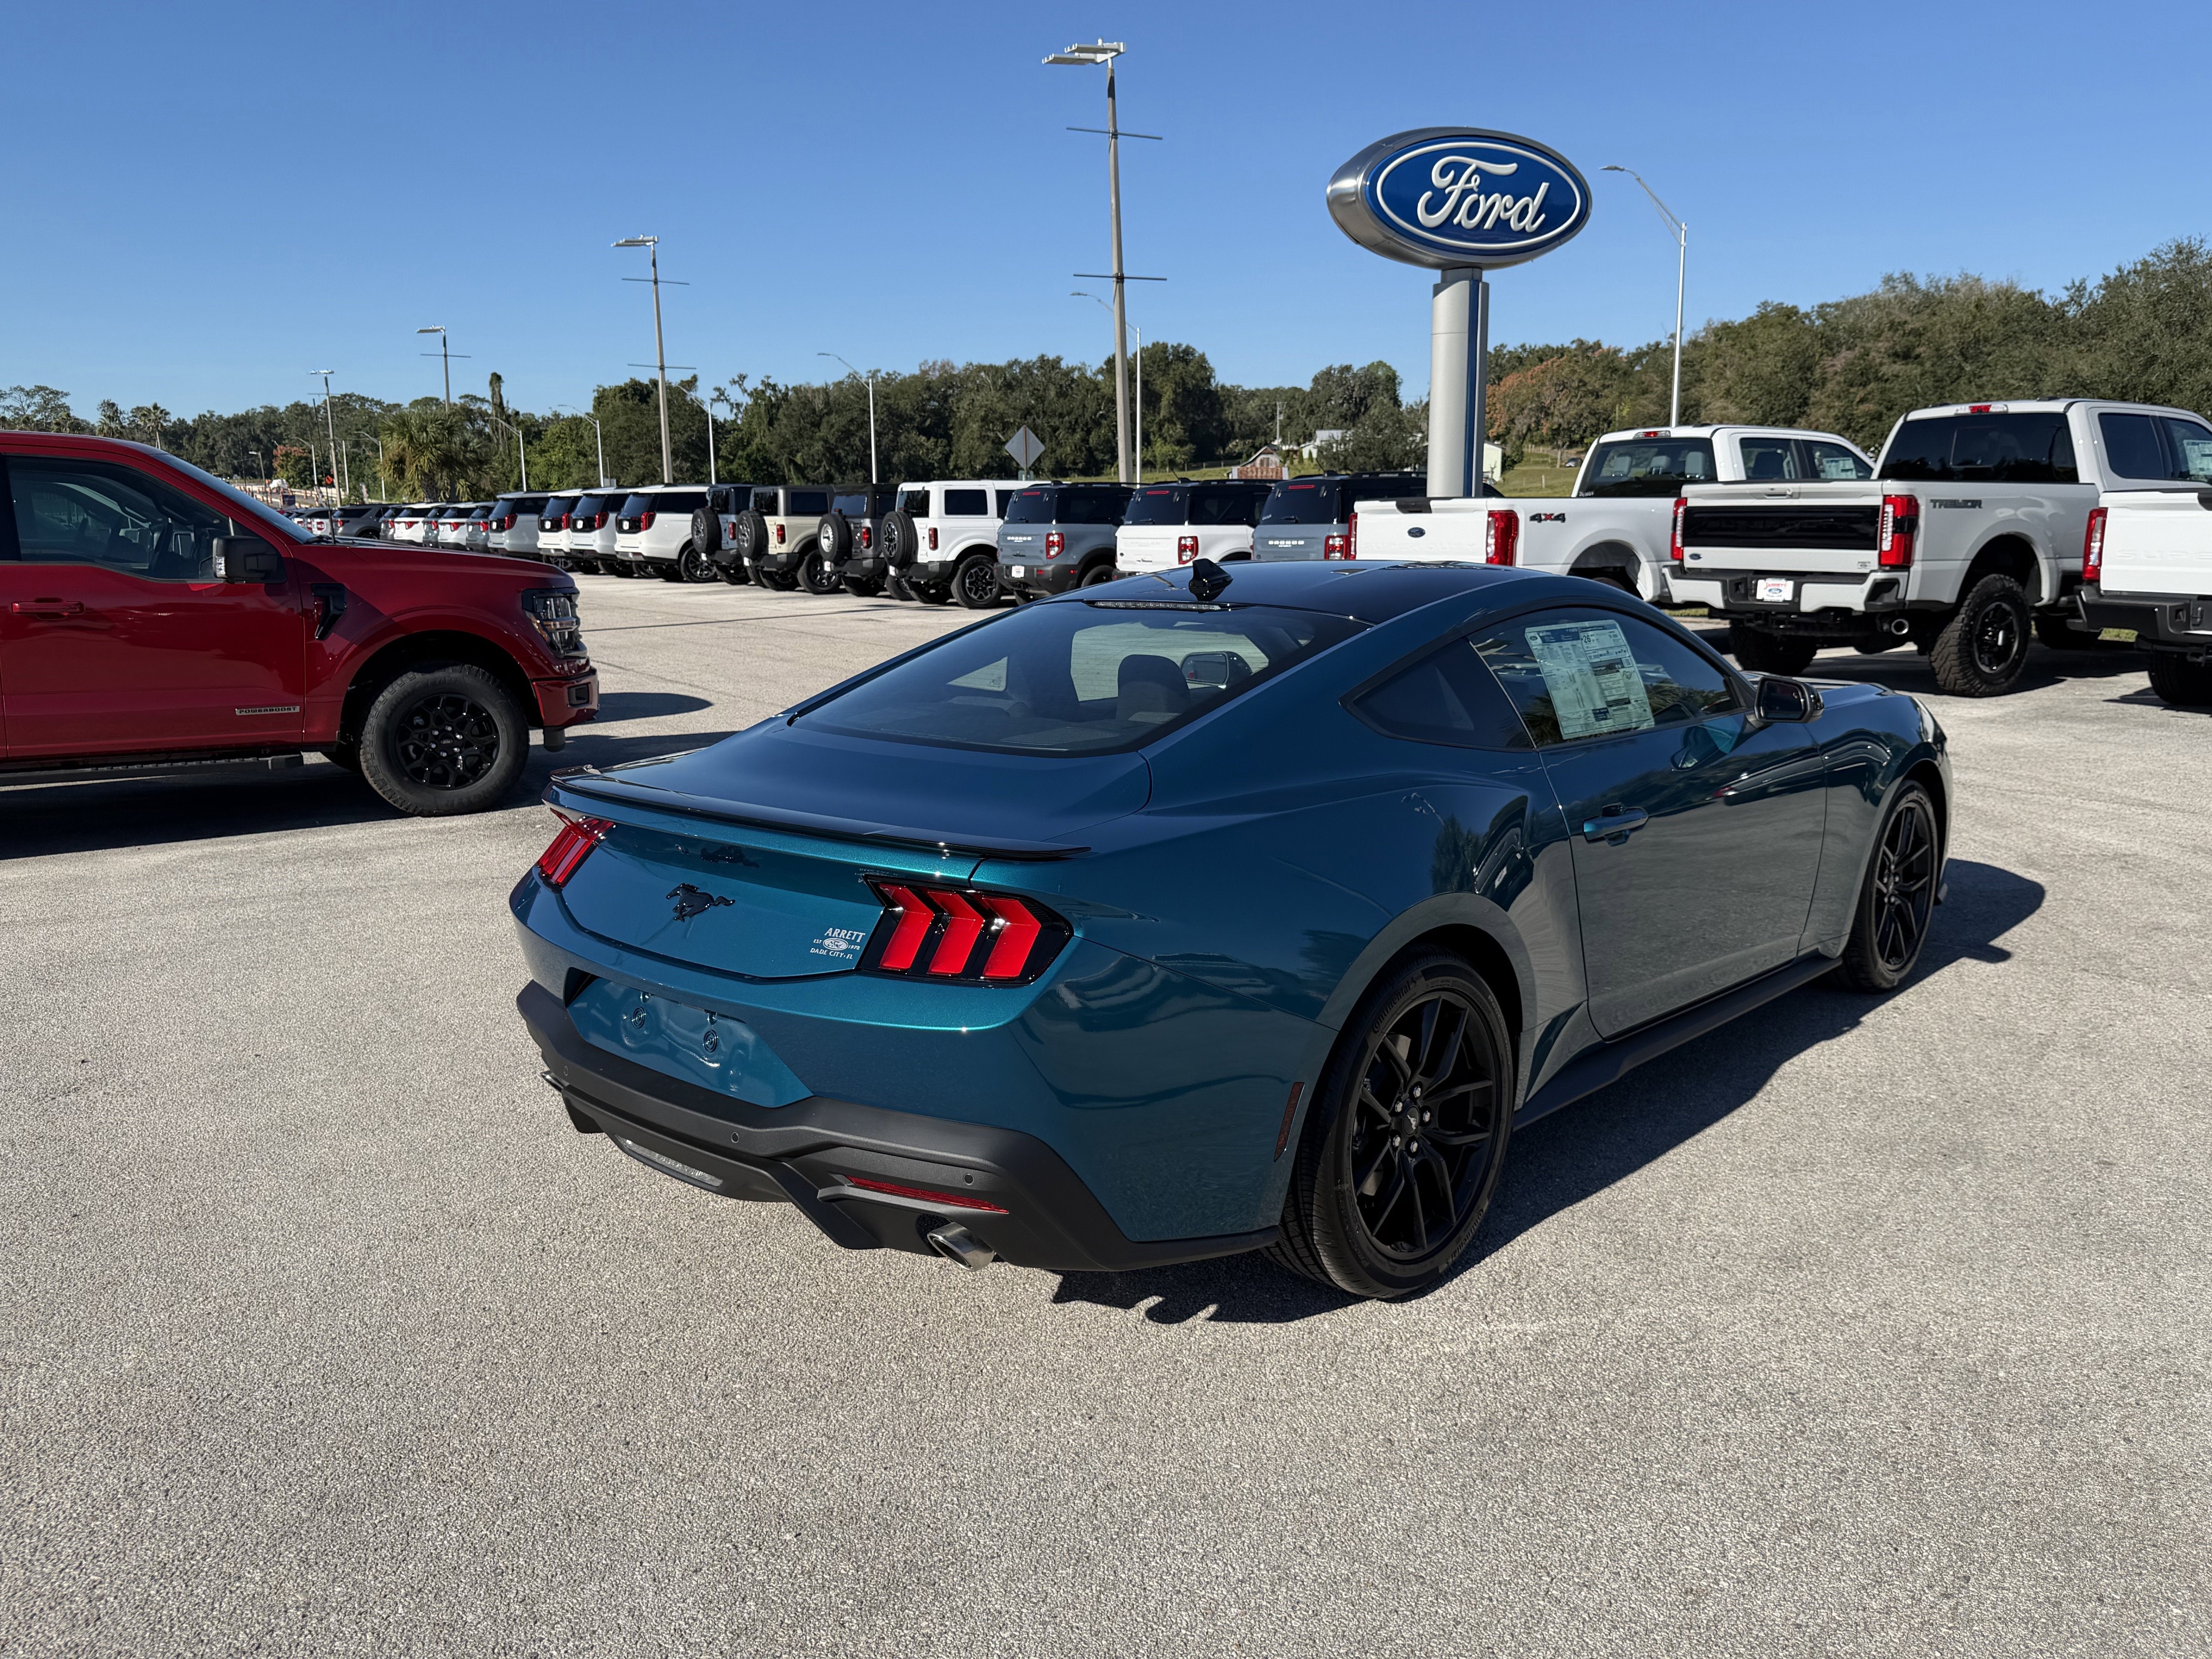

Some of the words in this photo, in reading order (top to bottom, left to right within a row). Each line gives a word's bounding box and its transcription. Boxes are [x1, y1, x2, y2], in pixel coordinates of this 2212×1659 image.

[1417, 155, 1549, 233] Ford
[1930, 499, 1982, 509] TREMOR
[824, 927, 866, 943] ARRETT
[1371, 980, 1411, 1034] Continental
